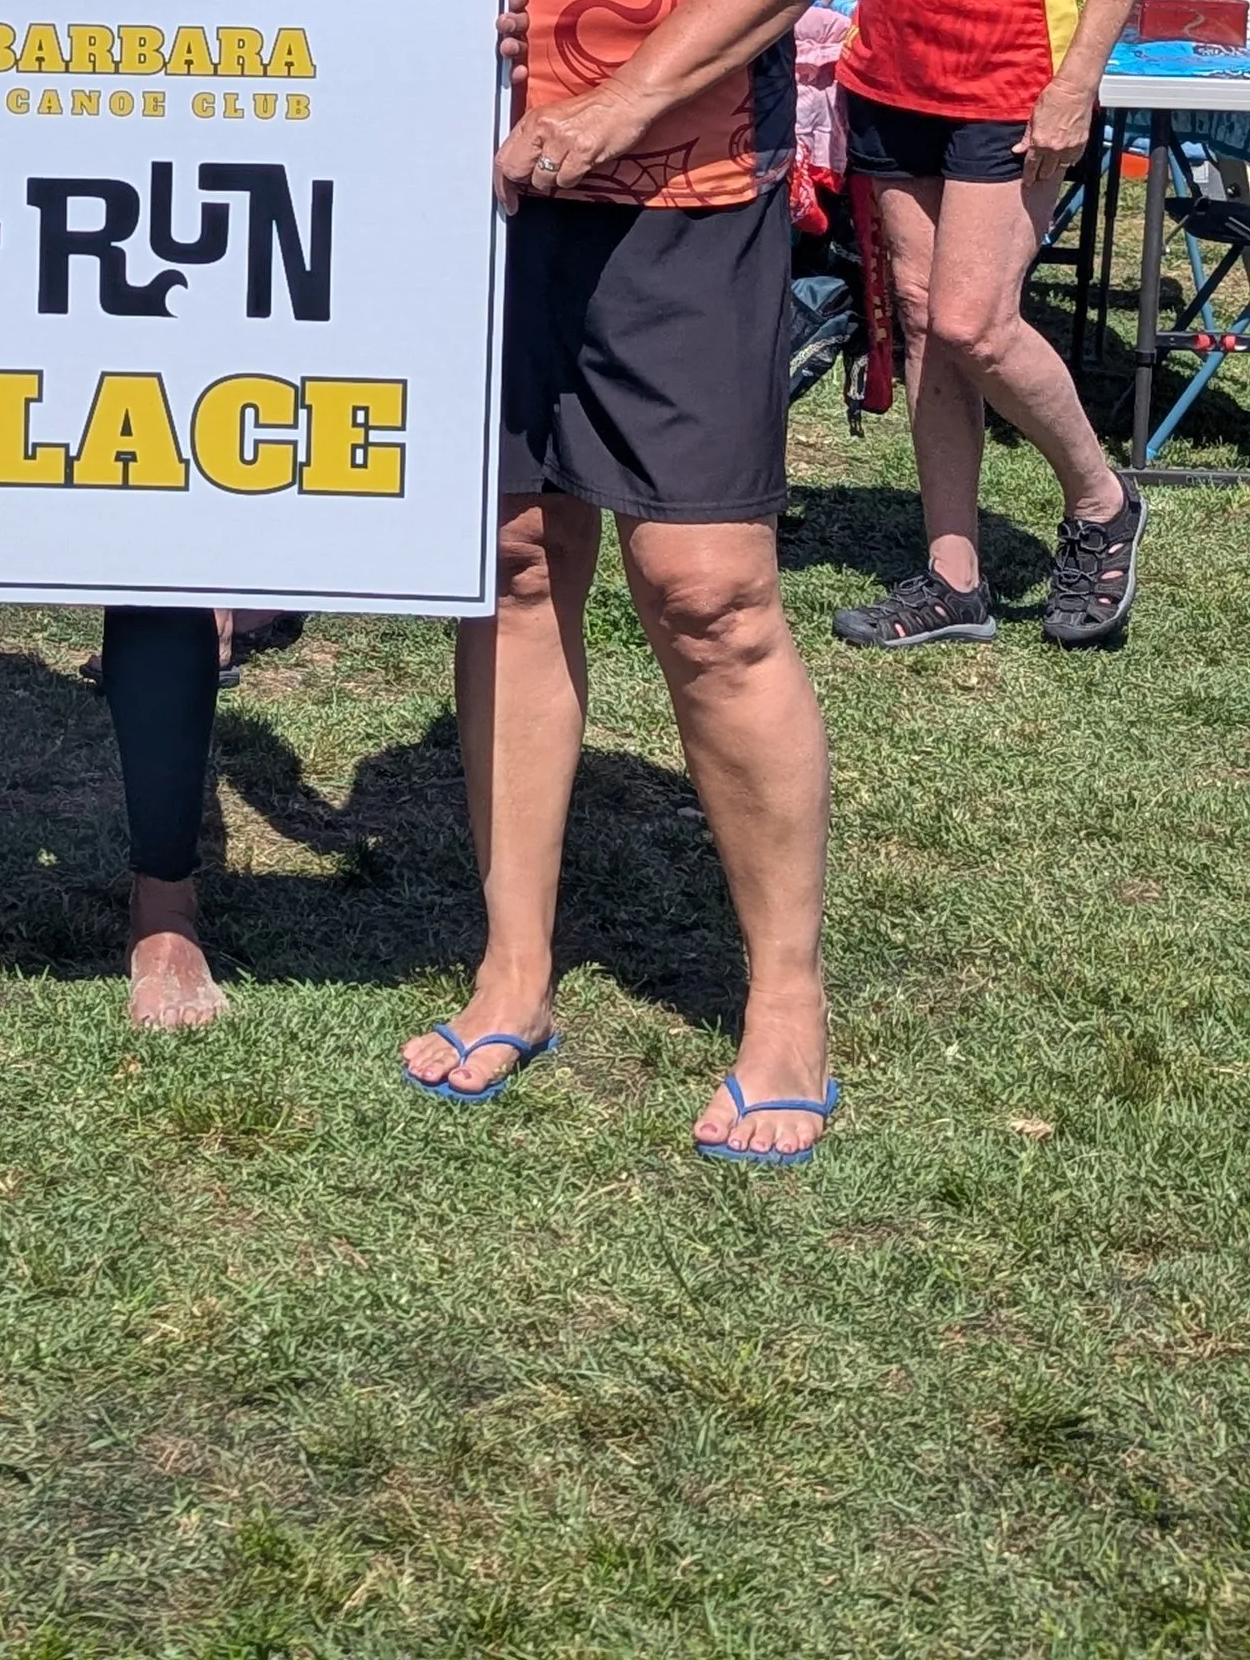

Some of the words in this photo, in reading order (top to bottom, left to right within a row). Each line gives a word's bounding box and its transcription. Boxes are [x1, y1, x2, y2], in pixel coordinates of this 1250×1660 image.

[6, 88, 165, 117] CANOE
[192, 92, 310, 120] CLUB
[26, 160, 334, 322] RUN
